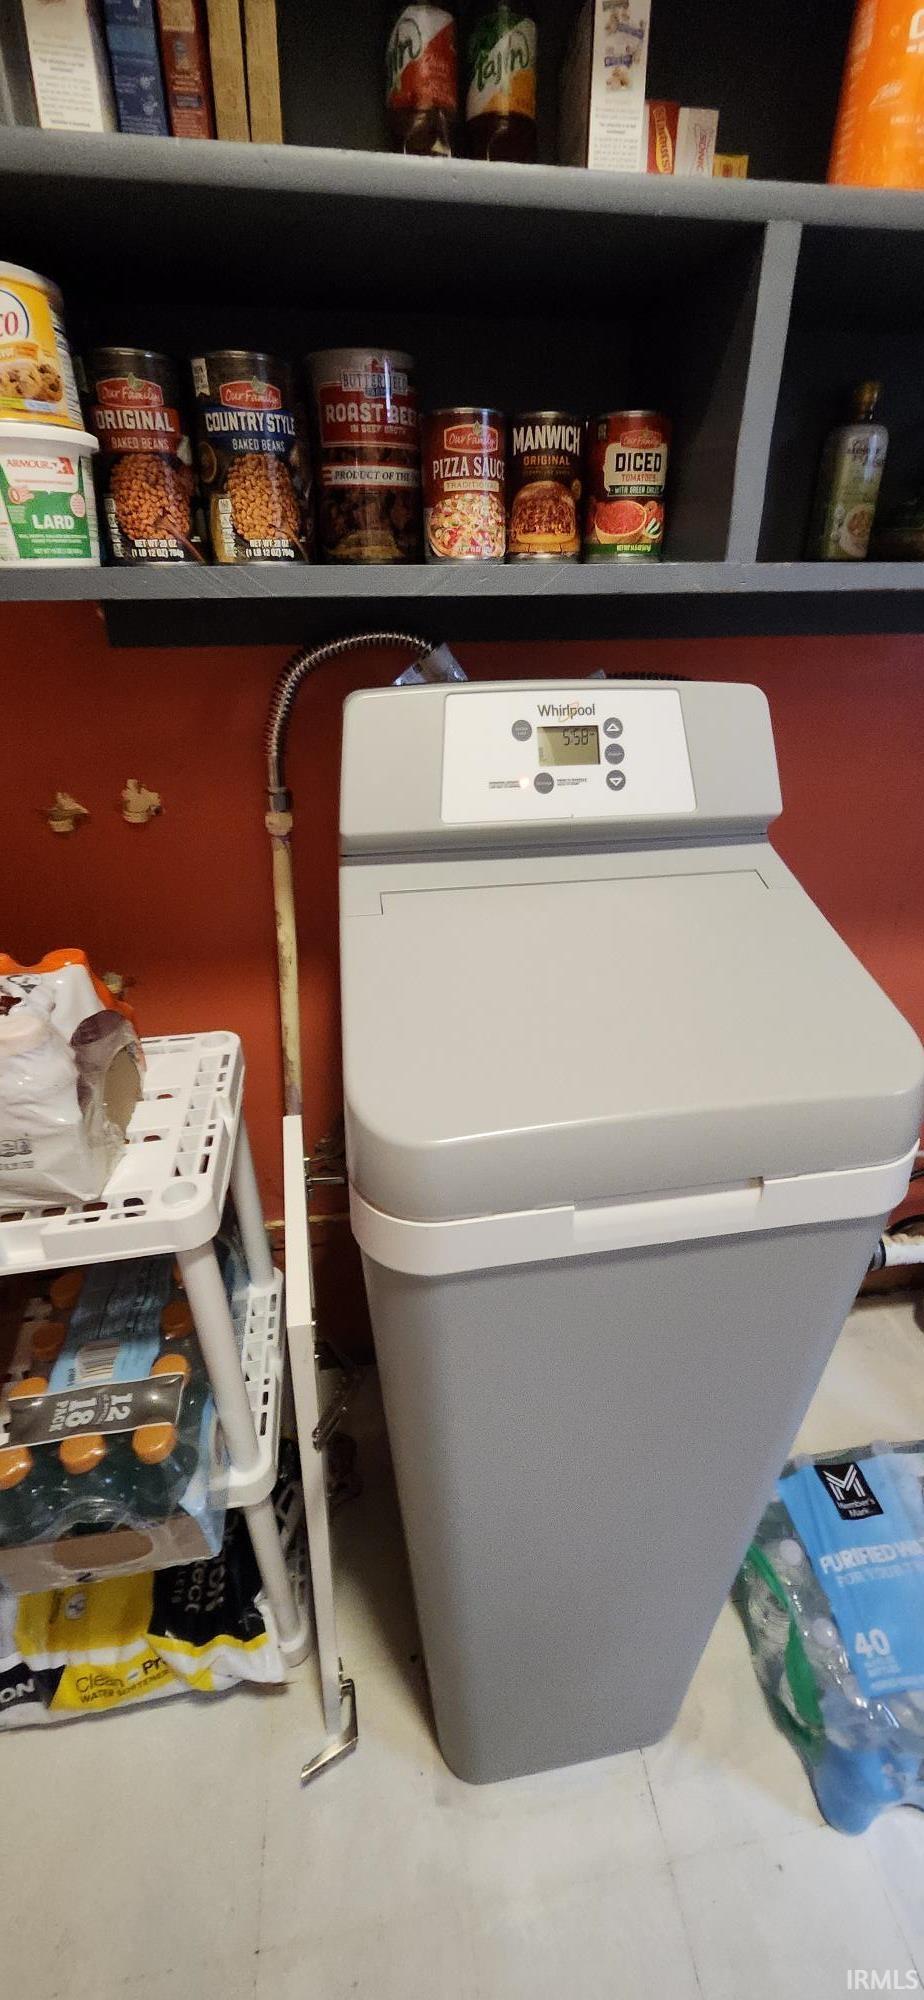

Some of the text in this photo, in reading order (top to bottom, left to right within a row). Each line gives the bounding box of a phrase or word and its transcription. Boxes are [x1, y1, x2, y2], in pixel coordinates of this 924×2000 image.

[95, 409, 176, 432] ORIGINAL
[326, 401, 385, 423] ROAST
[205, 411, 296, 436] COUNTRY STYLE
[111, 436, 170, 450] BAKED BEANS
[232, 438, 286, 452] BAKED BEANS
[513, 425, 580, 457] MANWICH
[433, 456, 470, 481] PIZZA
[523, 455, 571, 466] ORIGINAL
[614, 452, 662, 473] DICED
[334, 469, 379, 481] PRODUCT
[381, 470, 394, 481] OF
[445, 480, 498, 491] TRADITIONAL
[31, 513, 75, 530] LARD
[537, 703, 596, 720] Whirlpool
[820, 1543, 897, 1574] PURIFIED
[855, 1627, 891, 1659] 40
[75, 1672, 125, 1693] Clean
